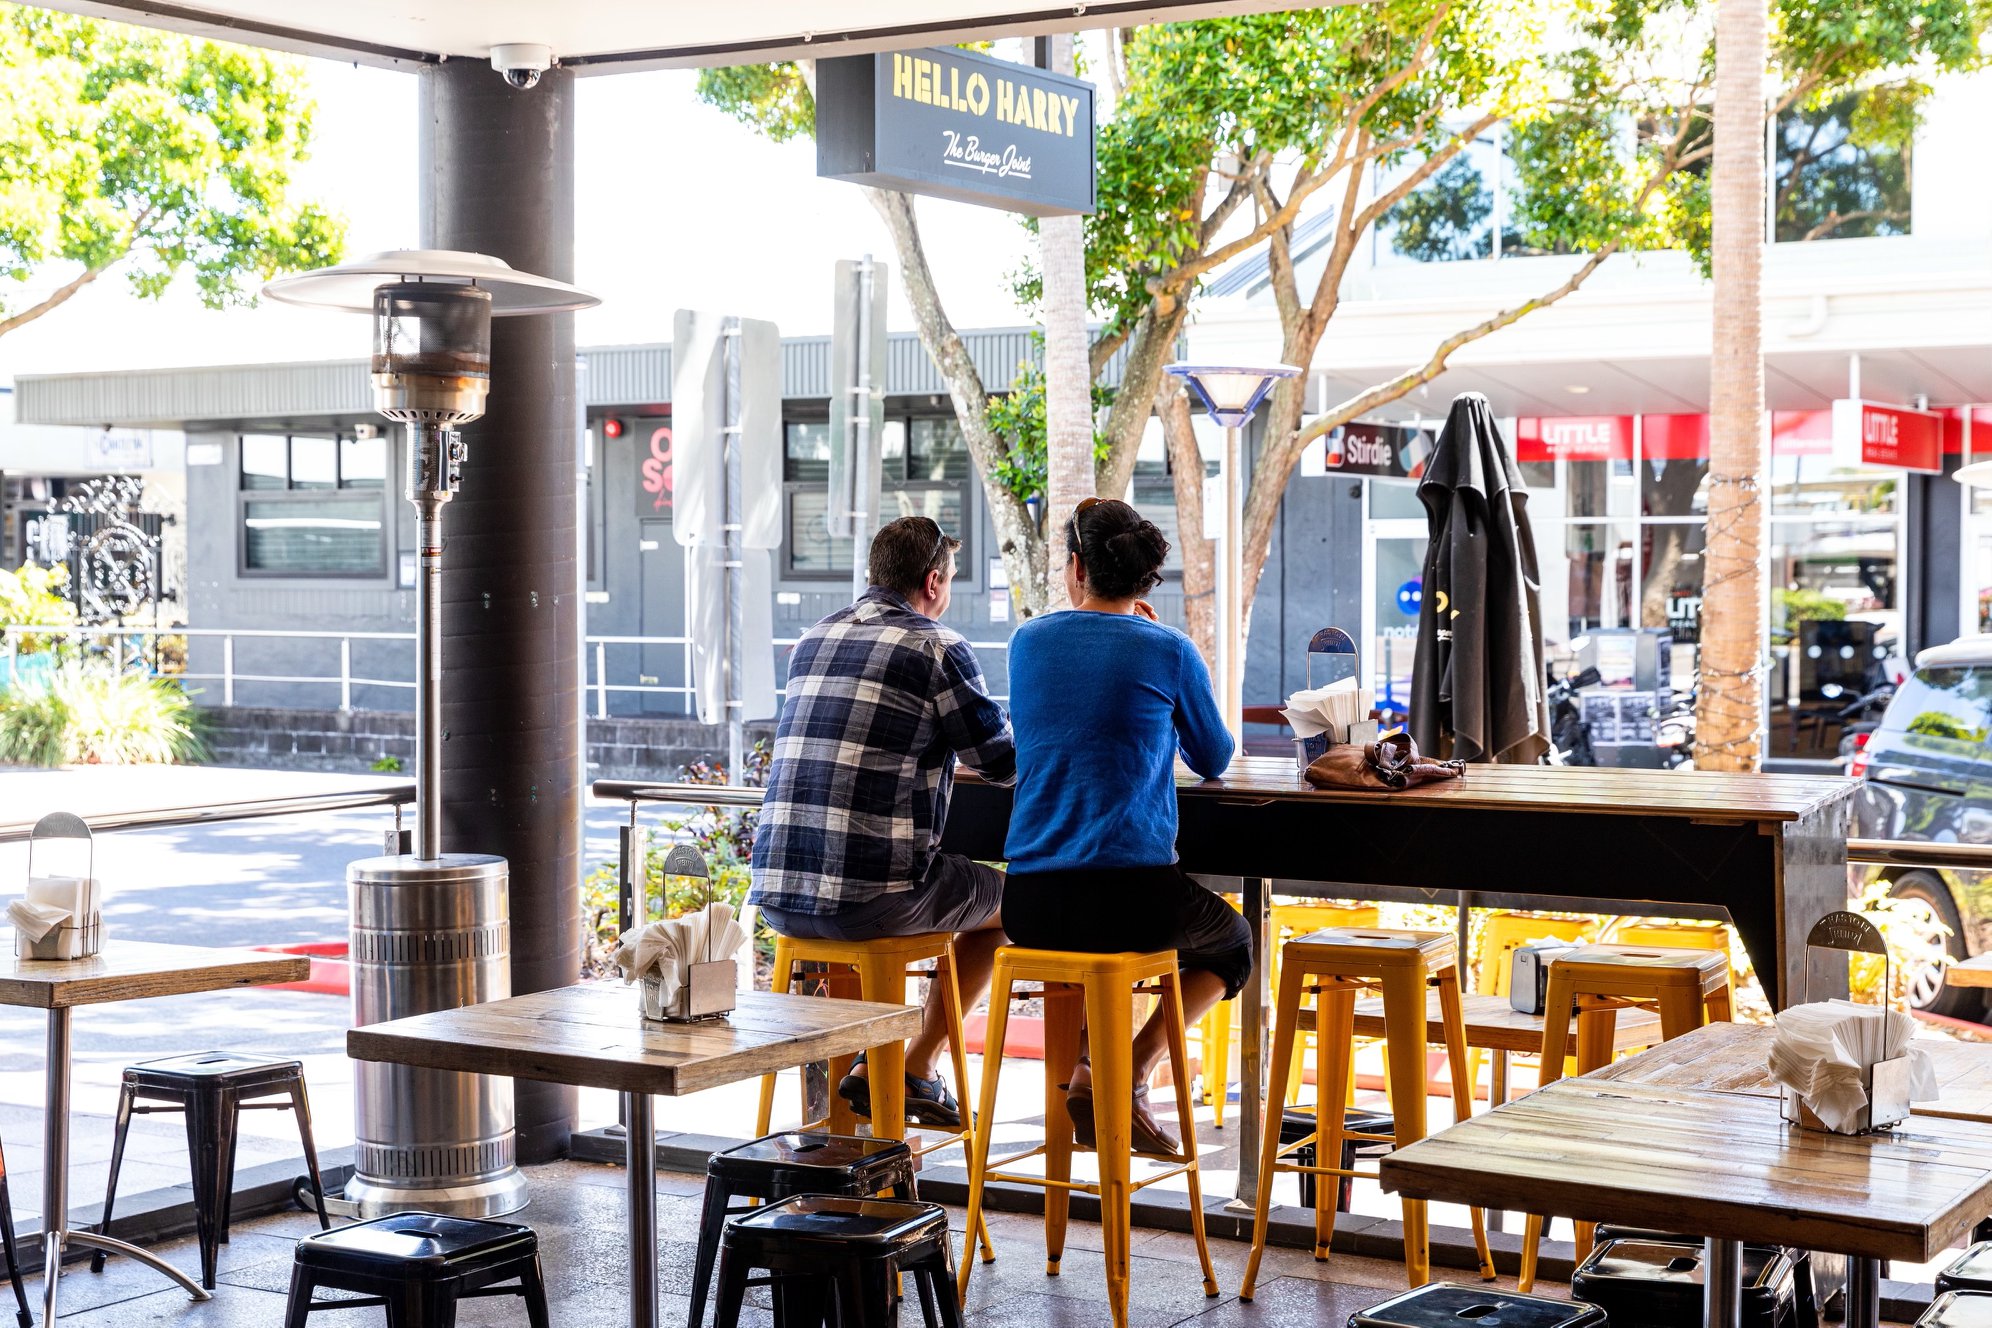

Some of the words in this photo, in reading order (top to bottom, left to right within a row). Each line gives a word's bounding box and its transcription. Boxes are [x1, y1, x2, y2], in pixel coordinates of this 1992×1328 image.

[893, 53, 990, 117] HELLO
[996, 78, 1080, 138] HARRY
[942, 130, 964, 159] The
[964, 135, 1001, 175] Burger
[998, 144, 1032, 178] Joint
[1541, 422, 1611, 445] LITTLE
[1863, 410, 1899, 447] LITTLE
[1346, 434, 1393, 466] Stirdie
